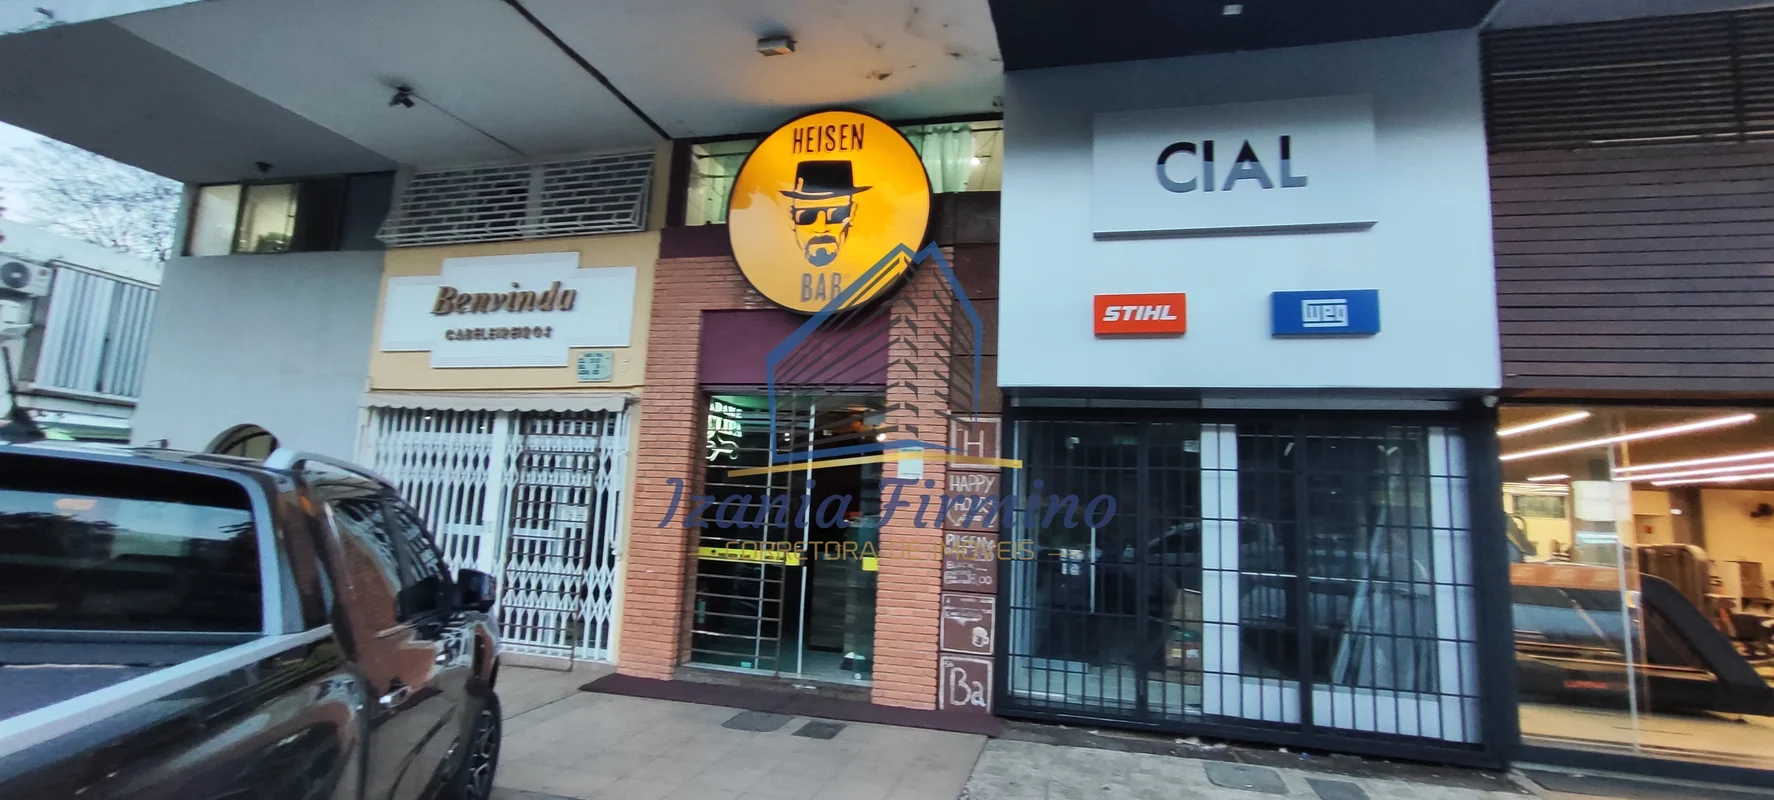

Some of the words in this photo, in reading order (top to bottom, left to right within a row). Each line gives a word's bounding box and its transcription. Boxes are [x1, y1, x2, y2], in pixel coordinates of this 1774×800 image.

[792, 123, 865, 154] HEISEN
[1156, 135, 1307, 193] CIAL
[801, 272, 842, 303] BAR
[1102, 304, 1178, 322] STIHL
[949, 474, 996, 494] HAPPY
